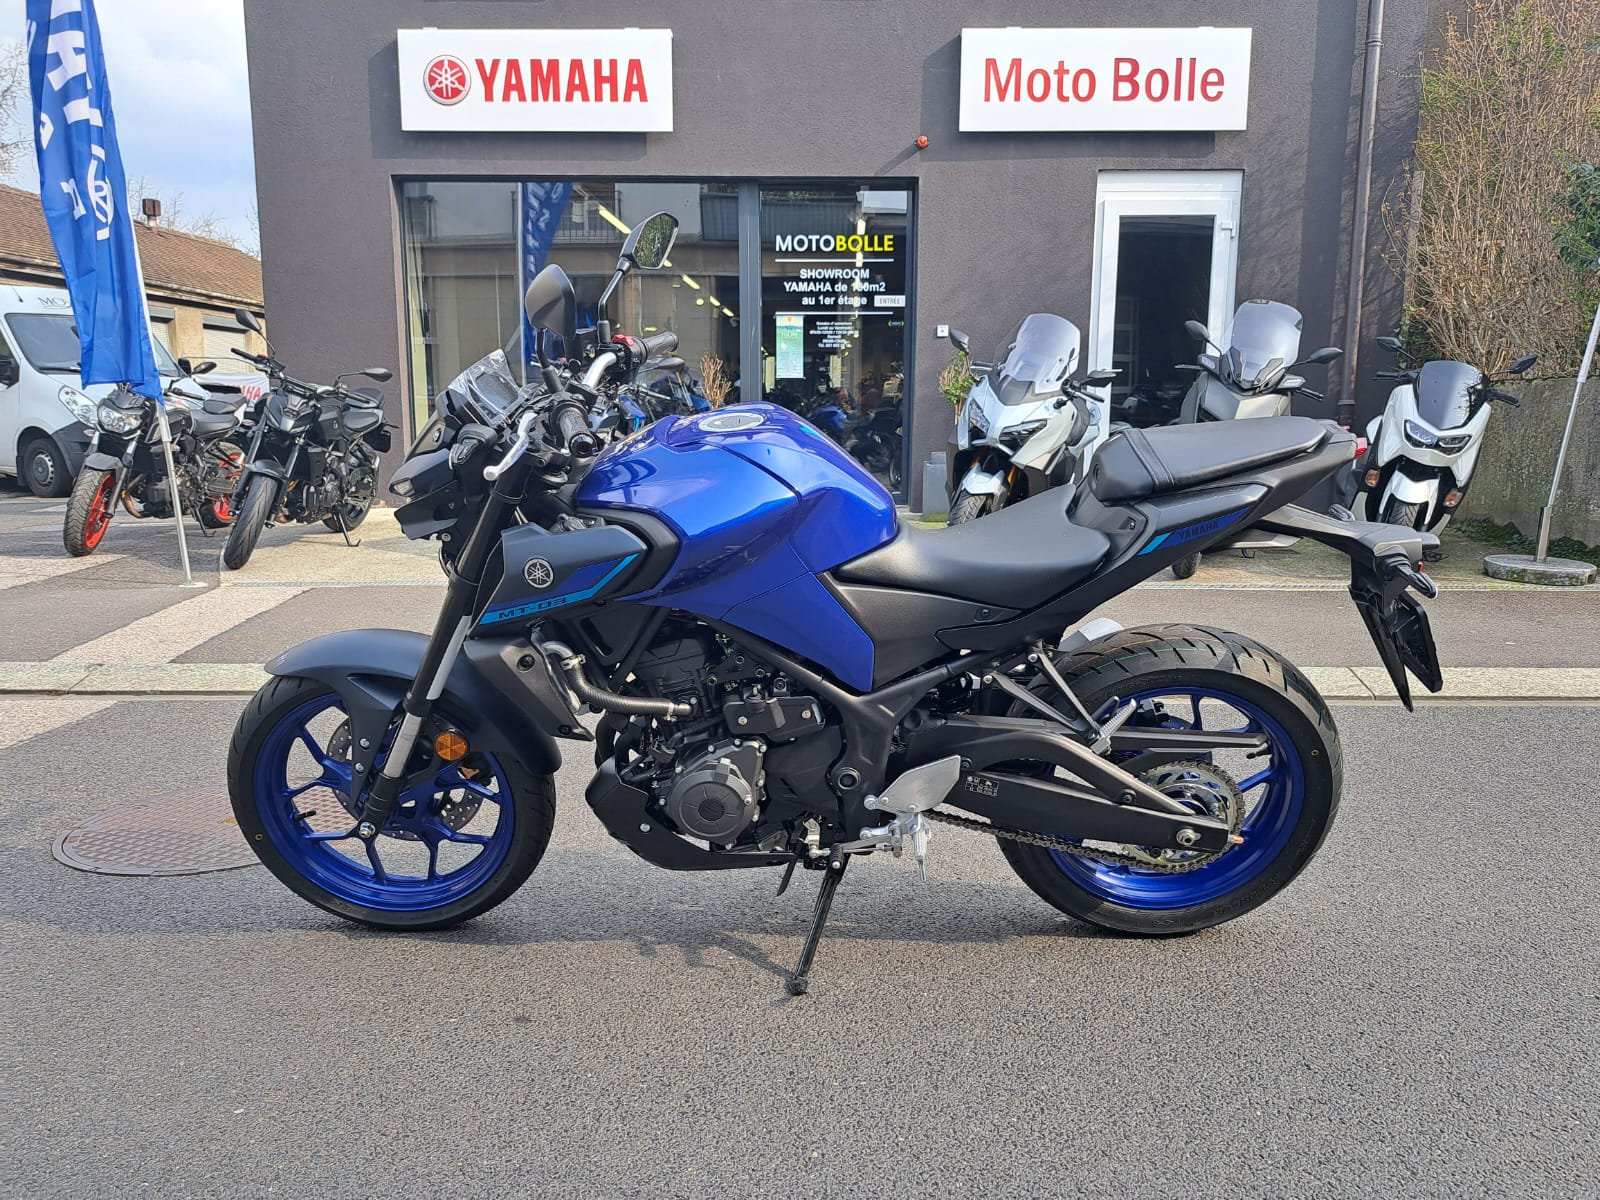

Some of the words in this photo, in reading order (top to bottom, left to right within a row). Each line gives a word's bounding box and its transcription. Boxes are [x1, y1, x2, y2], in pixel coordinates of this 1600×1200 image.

[475, 58, 649, 103] YAMAHA
[983, 57, 1097, 103] Moto
[1112, 57, 1226, 103] Bolle
[799, 268, 870, 279] SHOWROOM
[783, 282, 832, 292] YAMAHA
[834, 282, 848, 292] de
[802, 296, 815, 305] au
[818, 295, 836, 305] 1er
[1179, 521, 1219, 539] YAMAHA
[498, 597, 567, 620] MT-03
